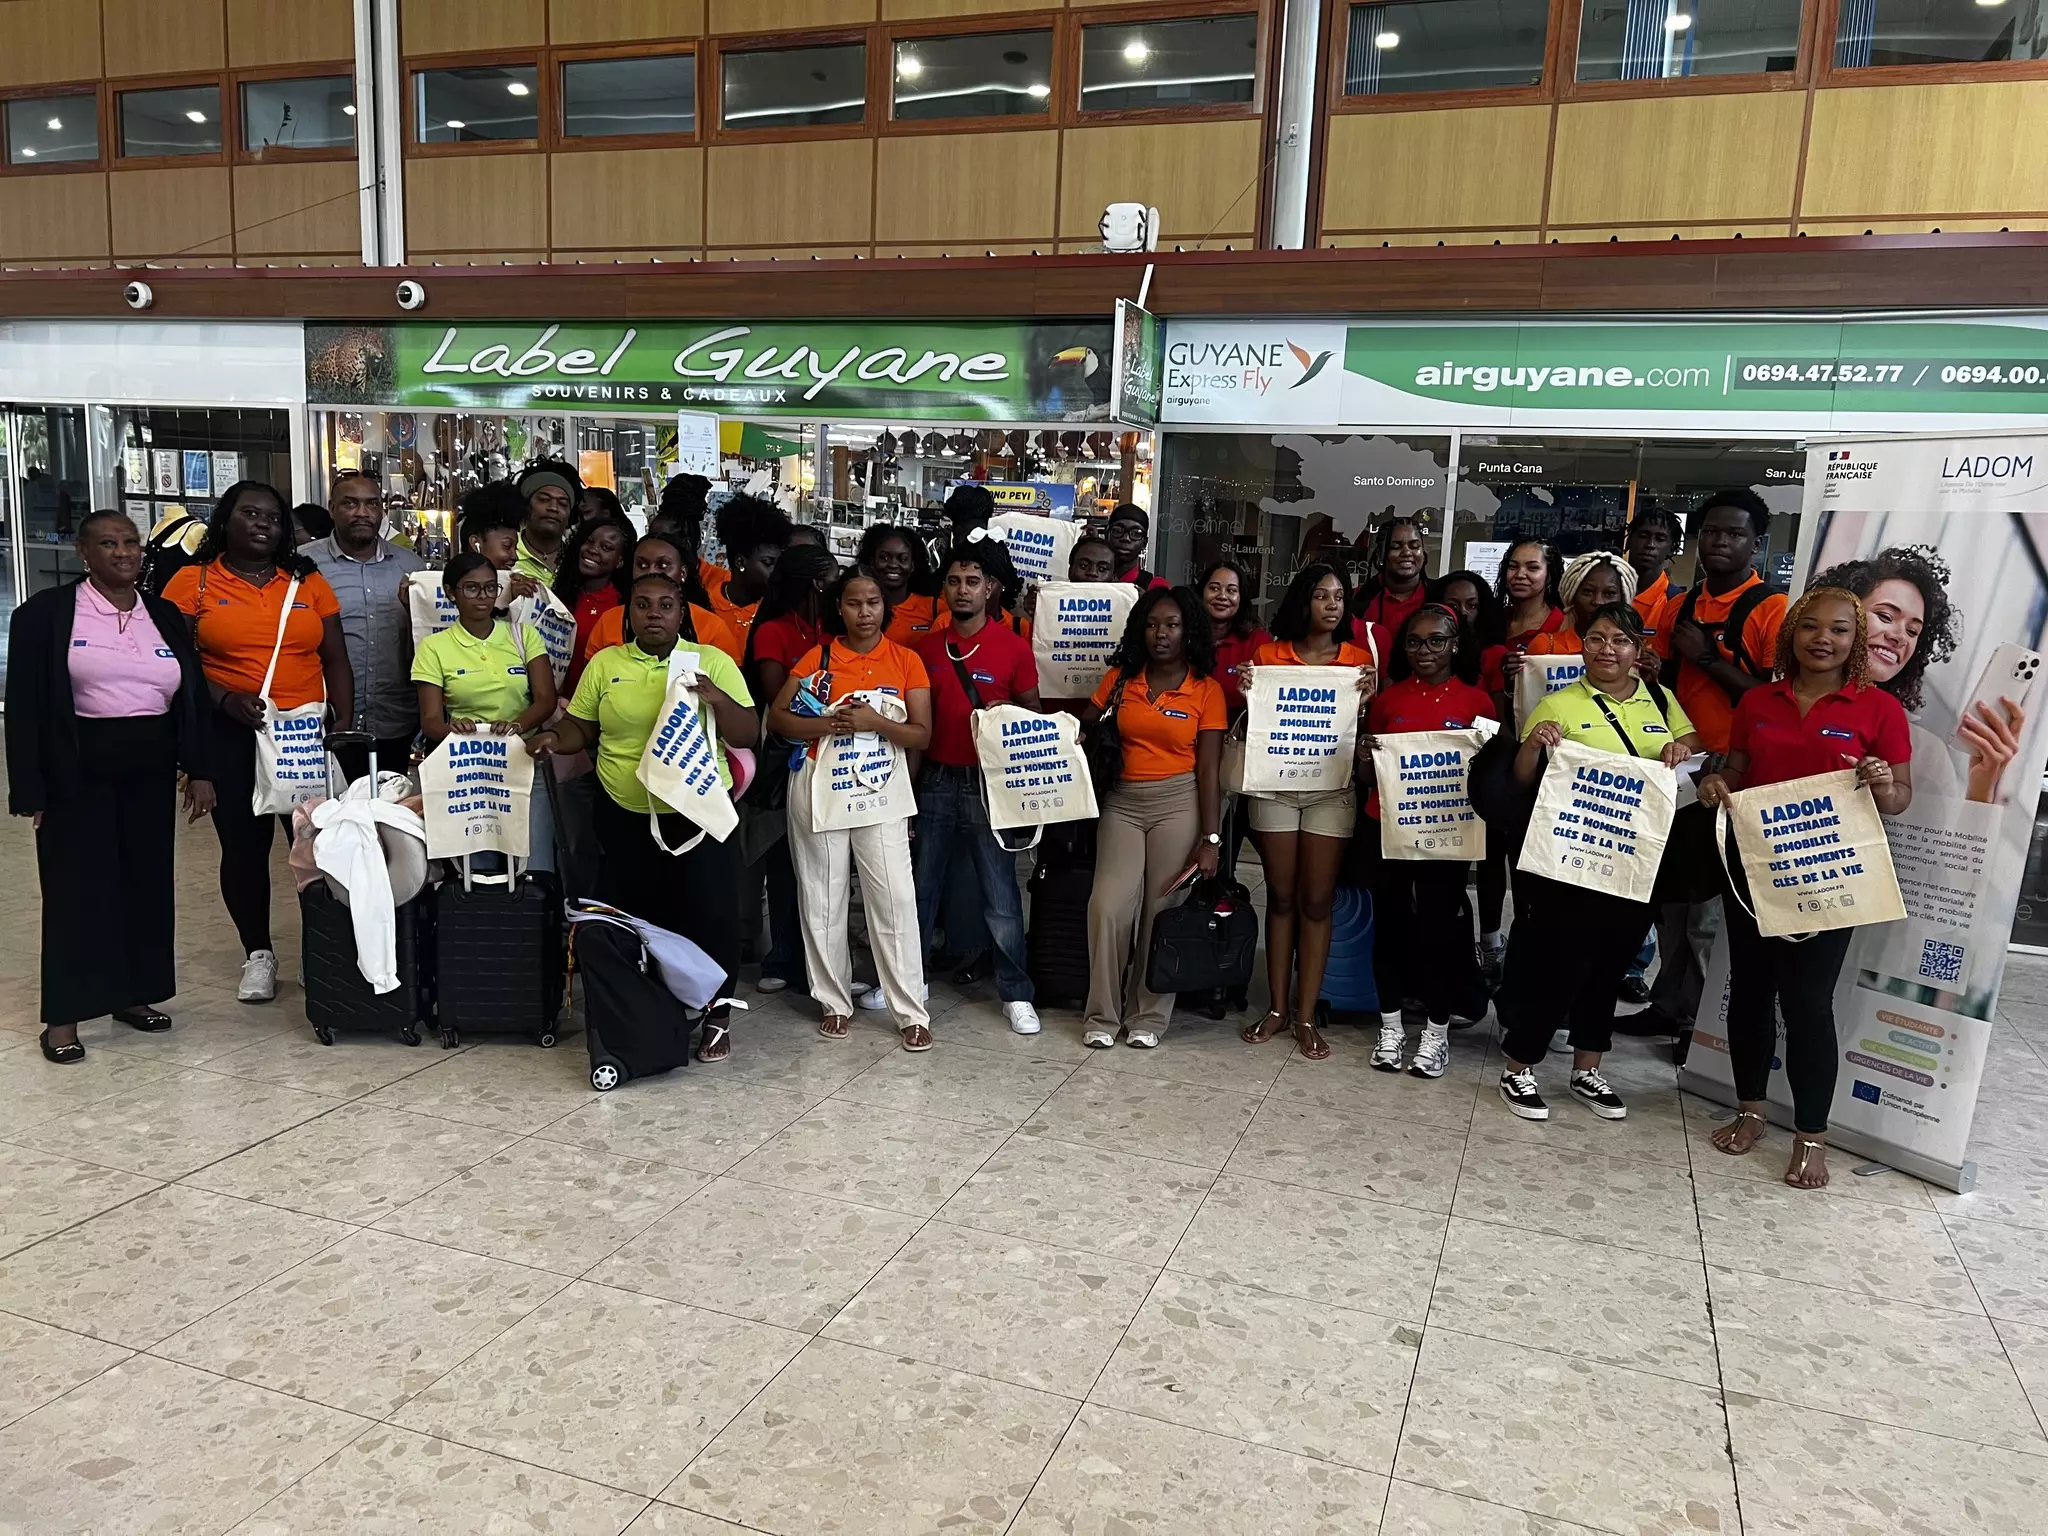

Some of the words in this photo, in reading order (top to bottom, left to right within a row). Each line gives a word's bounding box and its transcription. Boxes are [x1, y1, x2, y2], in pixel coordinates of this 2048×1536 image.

[422, 323, 637, 377] Label
[673, 326, 1010, 401] Guyane
[1168, 342, 1284, 368] GUYANE
[1130, 357, 1155, 382] Label
[1415, 361, 1710, 392] airguyane.com
[1742, 364, 1904, 382] 0694.47.52.77
[1168, 368, 1237, 395] Express
[1242, 366, 1273, 397] Fly
[532, 384, 649, 400] SOUVENIRS
[660, 387, 672, 401] &
[683, 387, 786, 403] CADEAUX
[1124, 377, 1155, 404] Guyane
[1166, 396, 1210, 406] airguyane
[1478, 462, 1511, 474] Punta
[1513, 462, 1543, 474] Cana
[1765, 468, 1786, 479] San
[1788, 468, 1807, 480] Jua
[1827, 462, 1878, 471] RÉPUBLIQUE
[1942, 455, 2033, 478] LADOM
[1353, 475, 1384, 487] Santo
[1386, 475, 1435, 488] Domingo
[1826, 471, 1873, 480] FRANÇAISE
[1007, 528, 1055, 547] LADOM
[1221, 543, 1275, 555] St-Laurent
[1010, 555, 1048, 569] MOBILITÉ
[1059, 599, 1111, 611] LADOM
[1062, 626, 1108, 636] #MOBILITÉ
[1073, 641, 1116, 649] MOMENTS
[1052, 652, 1072, 661] CLÉS
[1547, 665, 1587, 680] LADO
[1278, 687, 1336, 702] LADOM
[1276, 704, 1336, 714] PARTENAIRE
[651, 701, 692, 758] LADOM
[1002, 719, 1056, 737] LADOM
[1280, 718, 1331, 728] #MOBILITÉ
[663, 712, 699, 766] PARTENAIR
[1002, 732, 1060, 748] PARTENAIRE
[1270, 732, 1288, 741] DES
[1292, 733, 1338, 743] MOMENTS
[449, 741, 506, 757] LADOM
[1009, 745, 1058, 761] #MOBILITÉ
[1268, 745, 1289, 755] CLÉS
[1293, 747, 1305, 755] DE
[1308, 748, 1320, 756] LA
[277, 758, 294, 766] DES
[449, 757, 508, 769] PARTENAIRE
[1005, 766, 1021, 774] DES
[1024, 760, 1068, 772] MOMENTS
[1400, 751, 1461, 769] LADOM
[276, 769, 299, 779] CLÉS
[456, 772, 504, 783] #MOBILITÉ
[685, 766, 702, 786] DES
[832, 767, 848, 776] DES
[1400, 768, 1464, 781] PARTENAIRE
[697, 773, 717, 796] CLÉS
[832, 779, 853, 791] CLÉS
[870, 776, 878, 784] LA
[1005, 778, 1025, 788] CLÉS
[1029, 778, 1040, 786] DE
[1043, 776, 1054, 785] LA
[1056, 774, 1072, 783] VIE
[1577, 767, 1645, 794] LADOM
[448, 789, 467, 799] DES
[470, 786, 510, 798] MOMENTS
[1406, 782, 1461, 795] #MOBILITÉ
[1571, 782, 1642, 808] PARTENAIRE
[448, 802, 471, 814] CLÉS
[473, 801, 485, 810] DE
[489, 801, 497, 810] LA
[499, 804, 511, 813] VIE
[1398, 801, 1418, 811] DES
[1421, 798, 1471, 809] MOMENTS
[1572, 799, 1632, 822] #MOBILITÉ
[1760, 795, 1834, 825] LADOM
[1398, 814, 1422, 825] CLÉS
[1425, 815, 1438, 824] DE
[1441, 814, 1454, 823] LA
[1458, 812, 1474, 821] VIE
[1558, 812, 1580, 824] DES
[1582, 816, 1637, 840] MOMENTS
[1763, 815, 1841, 839] PARTENAIRE
[1553, 826, 1579, 840] CLÉS
[1581, 833, 1596, 844] DE
[1599, 838, 1613, 849] LA
[1617, 842, 1636, 855] VIE
[1773, 831, 1840, 854] #MOBILITÉ
[1924, 827, 1943, 835] pour
[1955, 832, 1988, 843] Mobilité
[1888, 841, 1922, 852] utre-mer
[1940, 851, 1968, 861] service
[1933, 840, 1967, 850] mobilité
[1769, 860, 1791, 872] DES
[1794, 847, 1856, 868] MOMENTS
[1944, 862, 1968, 871] social
[1772, 874, 1799, 888] CLÉS
[1802, 872, 1819, 884] DE
[1821, 868, 1839, 880] LA
[1841, 863, 1864, 876] VIE
[1923, 882, 1939, 891] met
[1901, 888, 1919, 896] nuité
[1924, 892, 1964, 907] territoriale
[1920, 913, 1935, 921] clés
[1939, 907, 1972, 919] mobilité
[1851, 1055, 1891, 1073] URGENCES
[1892, 1067, 1904, 1075] DE
[1905, 1071, 1914, 1080] LA
[1916, 1074, 1928, 1084] VIE
[1882, 1090, 1912, 1106] Cofinancé
[1902, 1106, 1940, 1123] européenne
